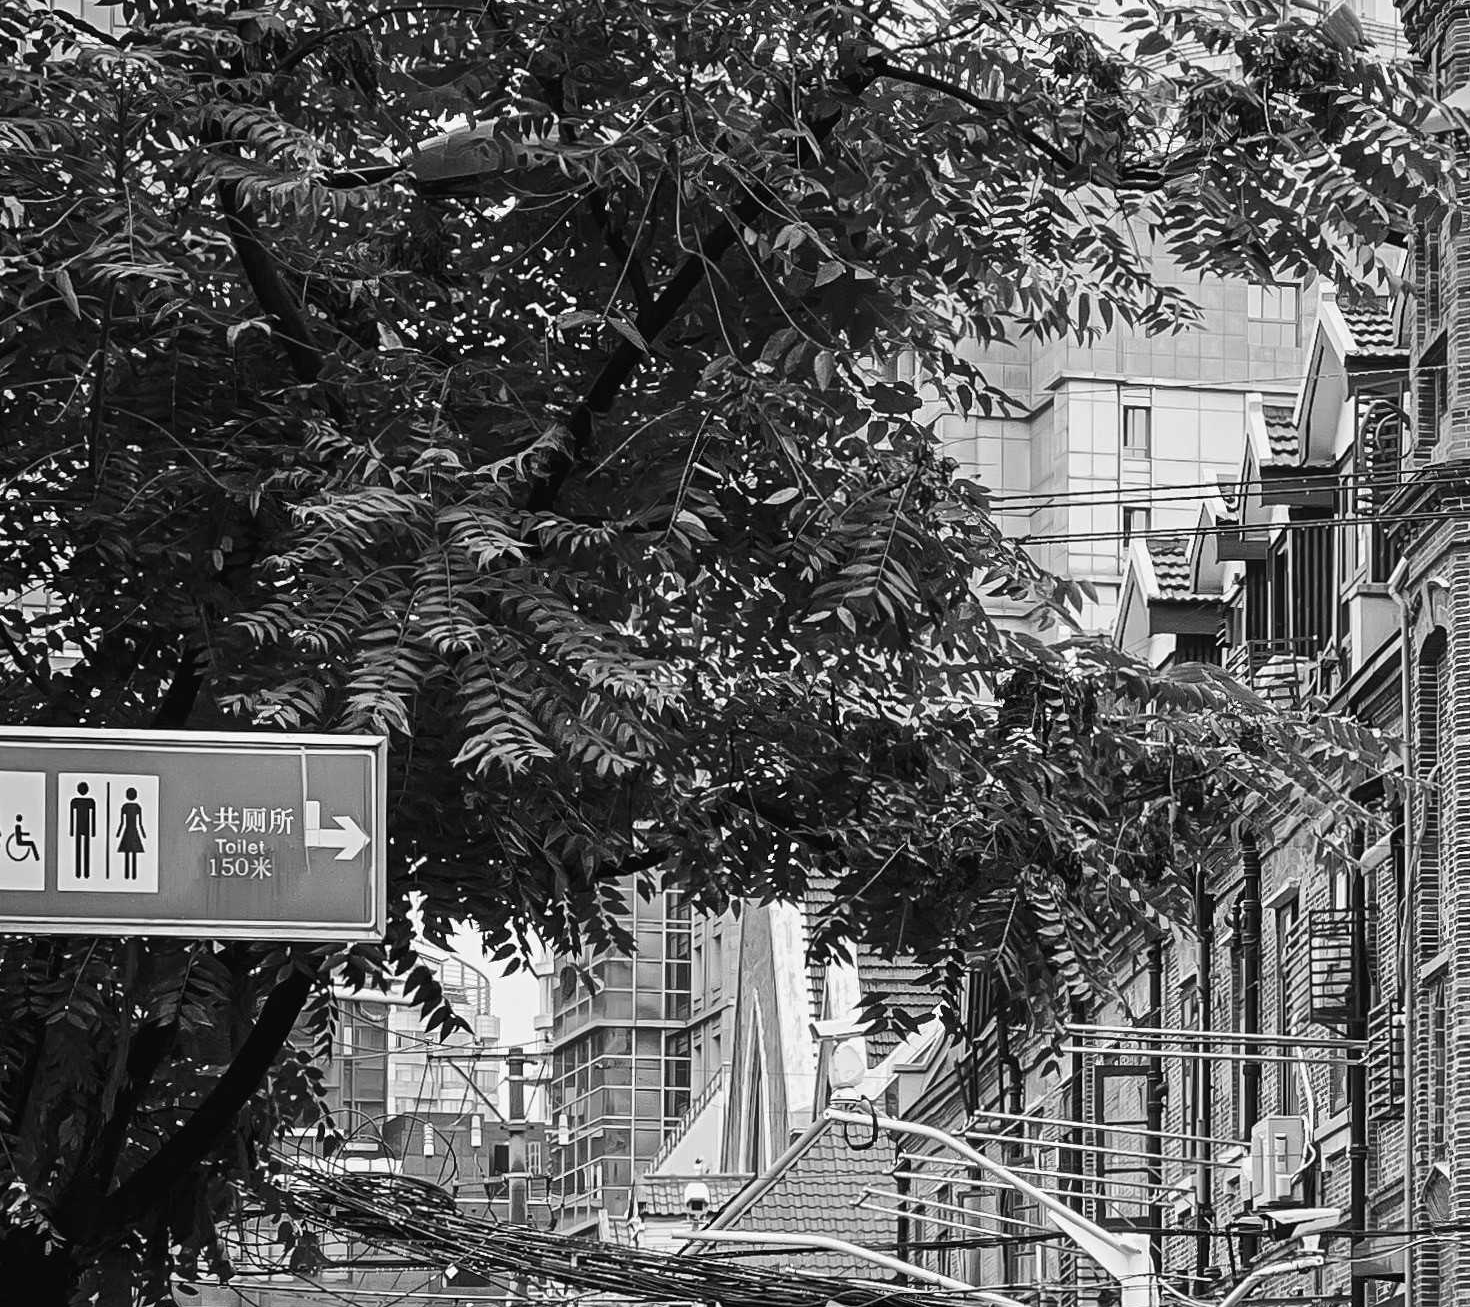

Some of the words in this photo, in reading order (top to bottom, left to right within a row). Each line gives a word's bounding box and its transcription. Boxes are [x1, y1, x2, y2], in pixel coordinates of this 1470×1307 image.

[184, 806, 295, 834] 公共厕所
[215, 838, 265, 854] Toilet
[209, 856, 273, 880] 150米
